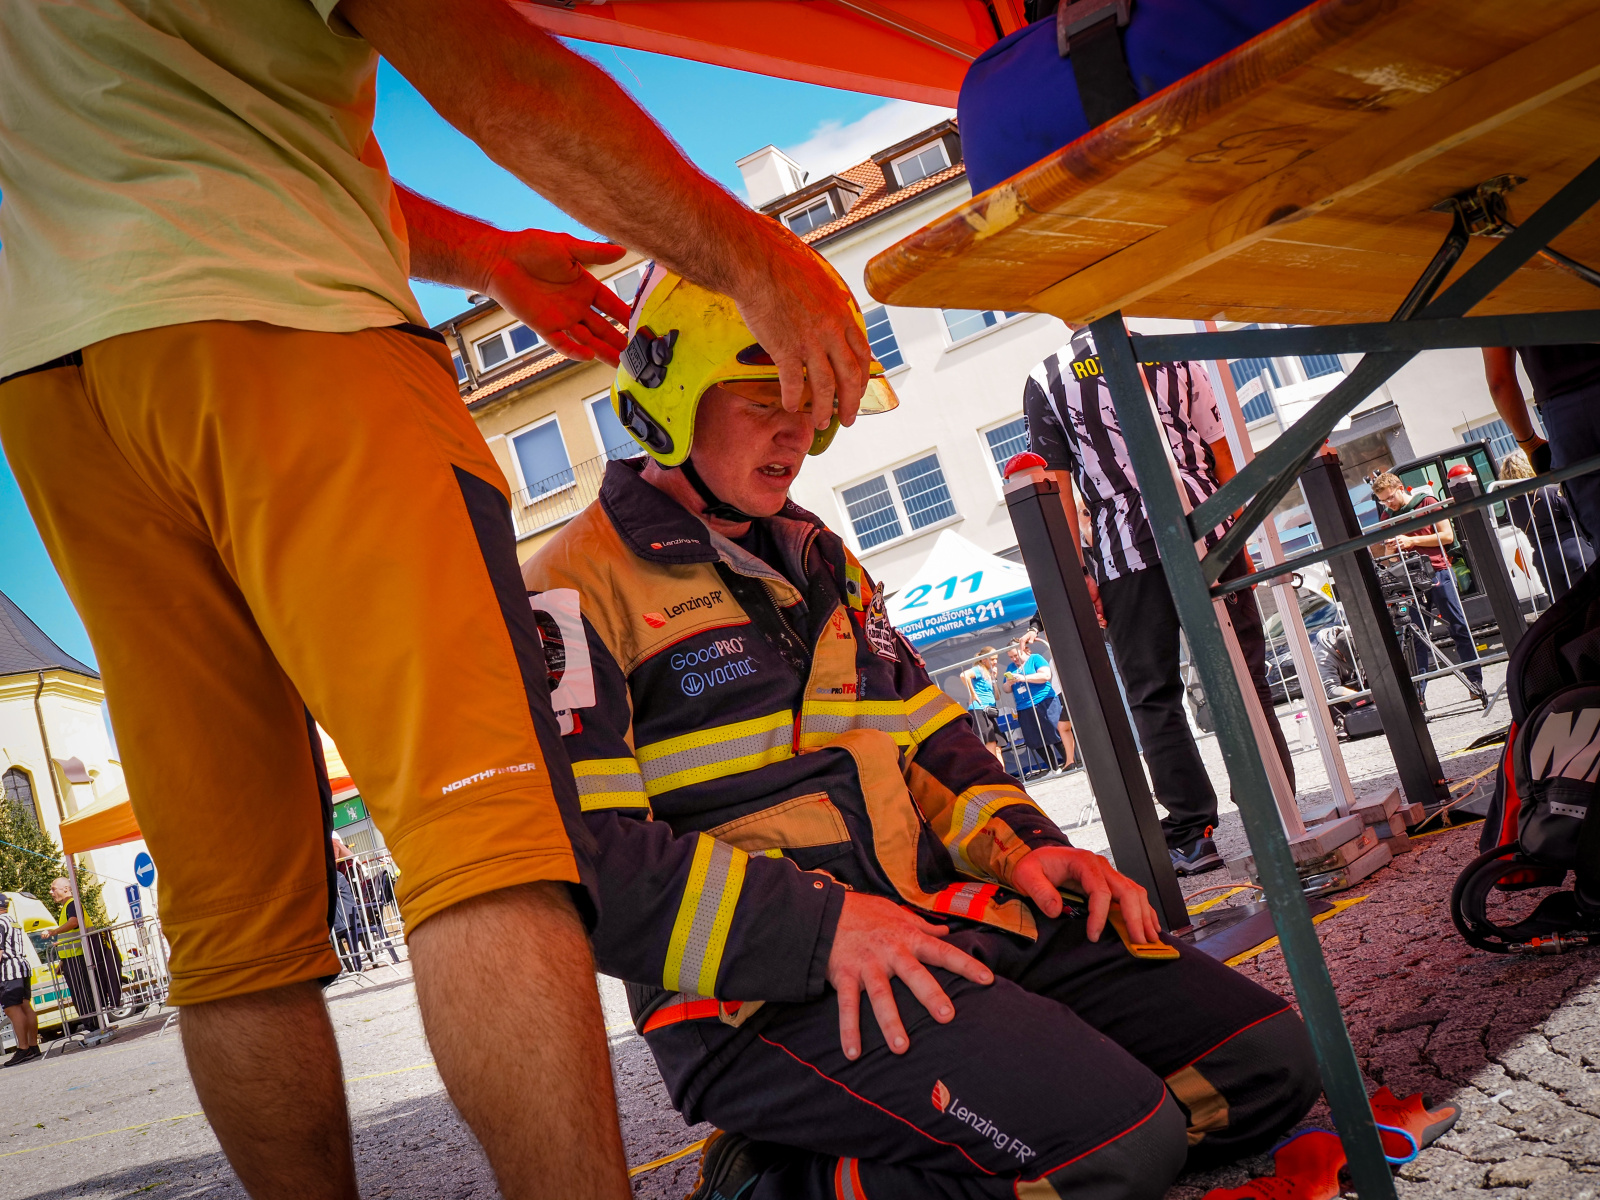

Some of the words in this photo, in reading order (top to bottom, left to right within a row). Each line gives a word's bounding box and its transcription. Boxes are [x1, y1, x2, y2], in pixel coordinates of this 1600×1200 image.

[899, 571, 983, 611] 211
[664, 596, 713, 619] Lenzing
[925, 607, 974, 627] POJIŠŤOVNA
[976, 600, 1006, 623] 211
[936, 620, 964, 633] VNITRA
[965, 616, 976, 625] ČR
[442, 762, 536, 794] NORTHFINDER
[949, 1098, 1009, 1149] Lenzing
